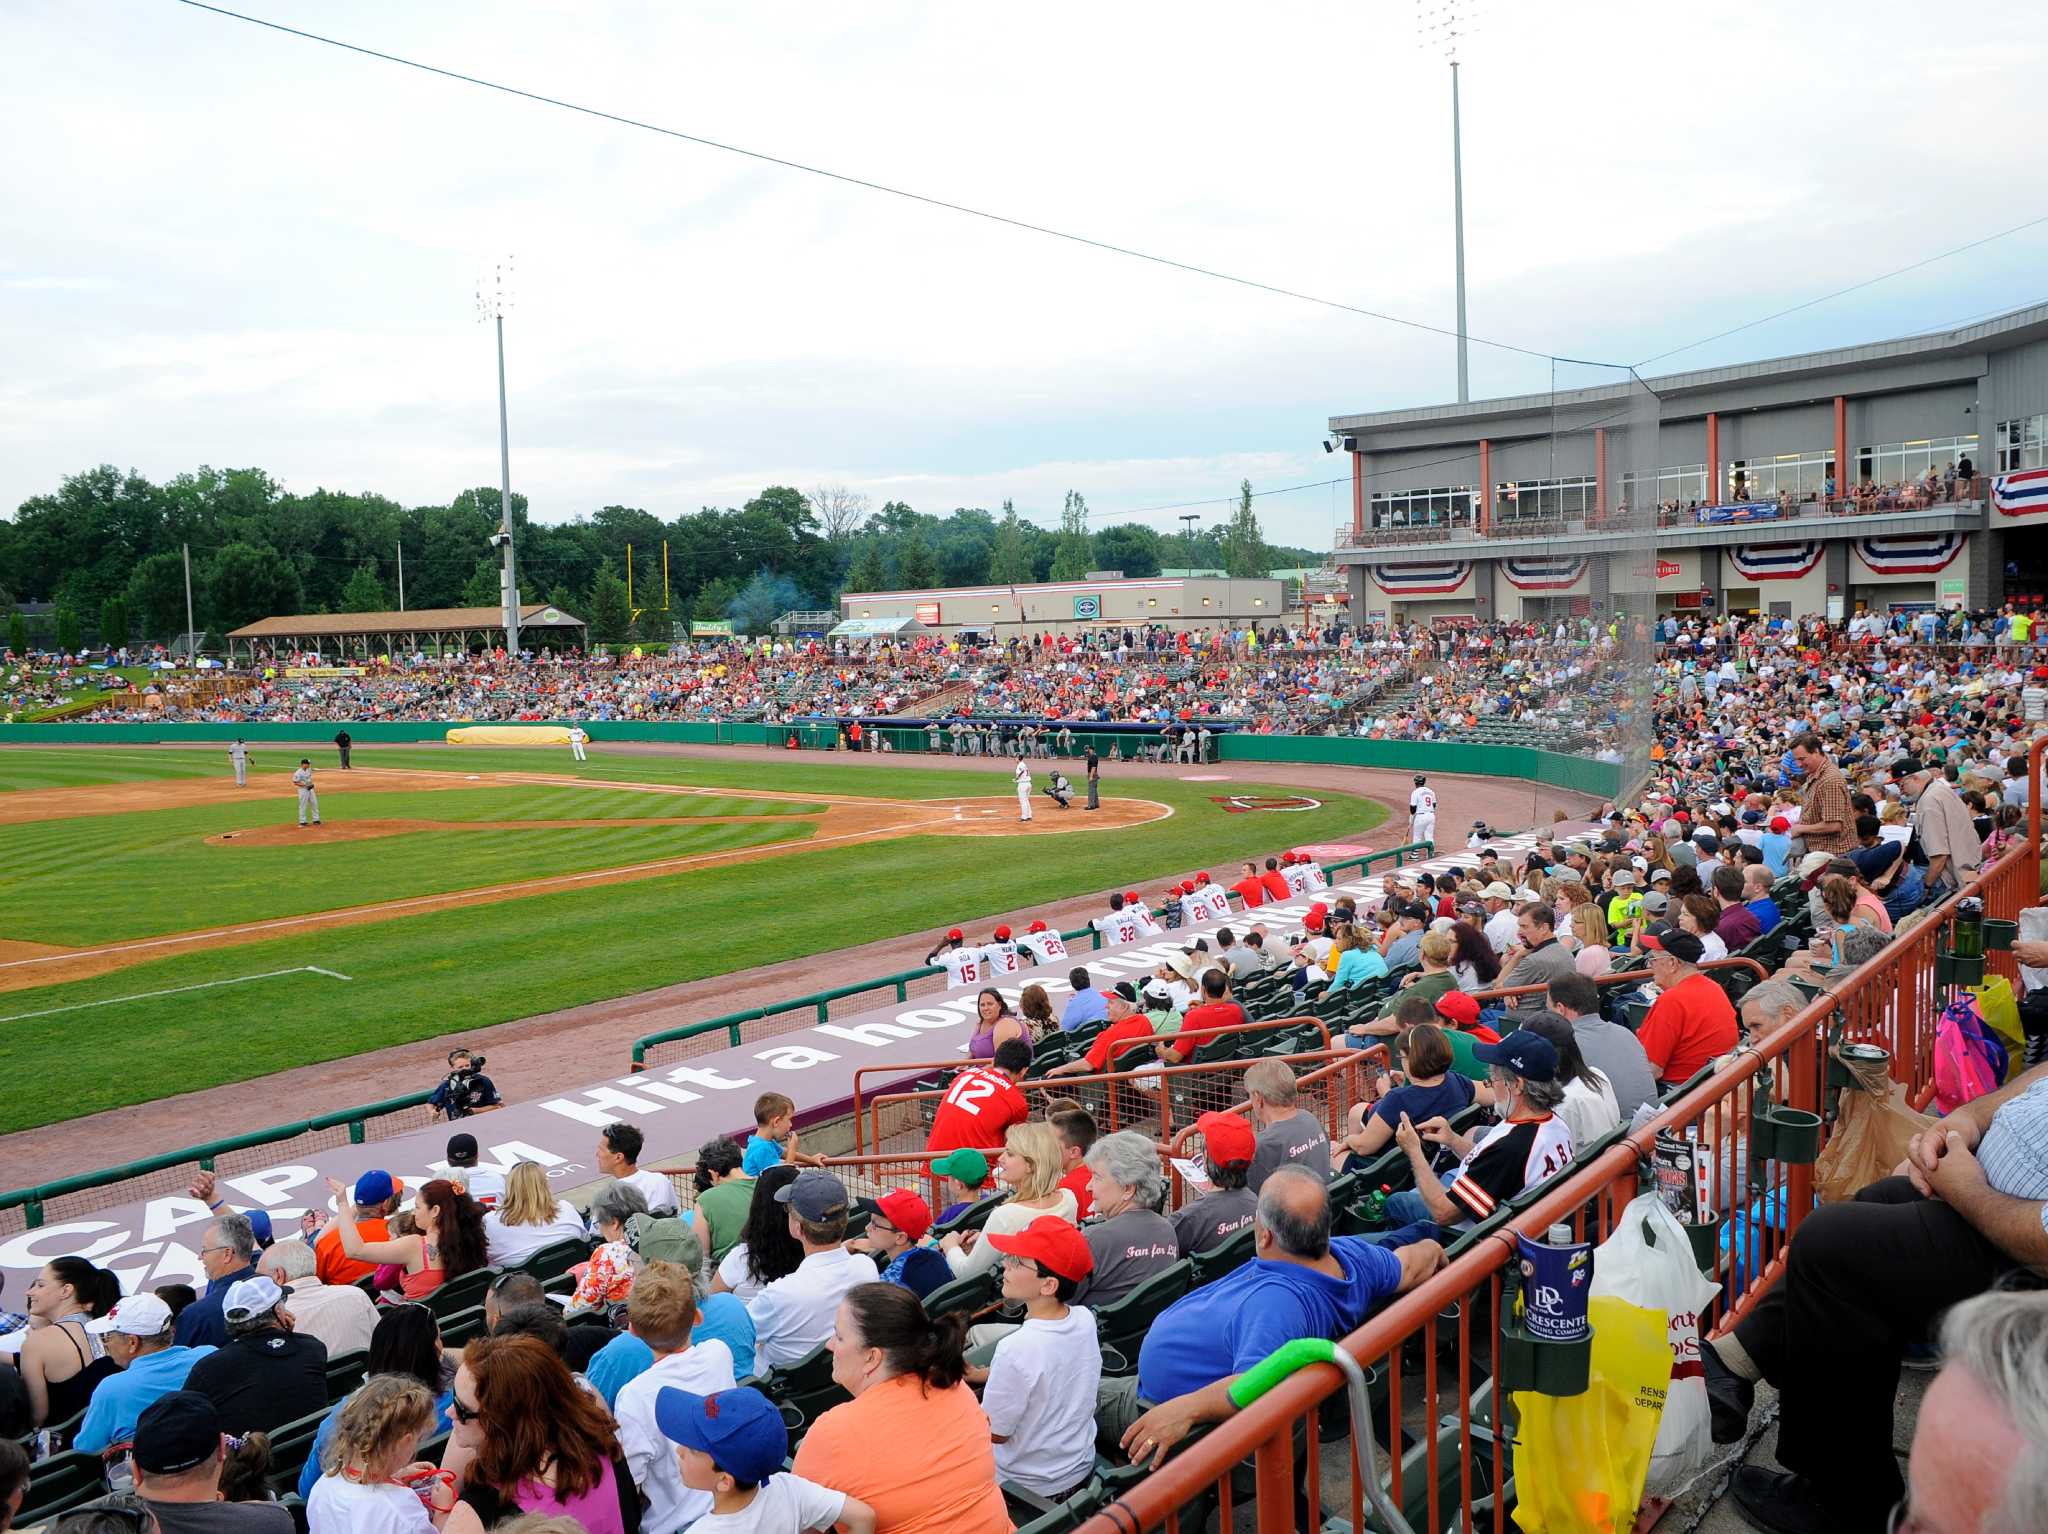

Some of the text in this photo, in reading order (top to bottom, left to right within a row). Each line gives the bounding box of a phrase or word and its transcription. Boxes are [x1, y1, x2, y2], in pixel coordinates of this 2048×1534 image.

[1211, 894, 1226, 910] 13
[1120, 926, 1134, 943] 32
[1006, 954, 1016, 971] 2
[960, 963, 976, 984] 15
[537, 1066, 756, 1127] Hit
[752, 1046, 842, 1069] a
[811, 977, 1074, 1048] home
[1076, 941, 1190, 978] run
[947, 1073, 995, 1116] 12
[1289, 1143, 1309, 1158] Fan
[0, 1165, 318, 1269] CAP
[1217, 1214, 1254, 1235] Fan for
[1126, 1246, 1149, 1259] Fan
[1151, 1244, 1165, 1258] for
[1640, 1386, 1667, 1400] RENS
[1635, 1397, 1664, 1412] DEPAR
